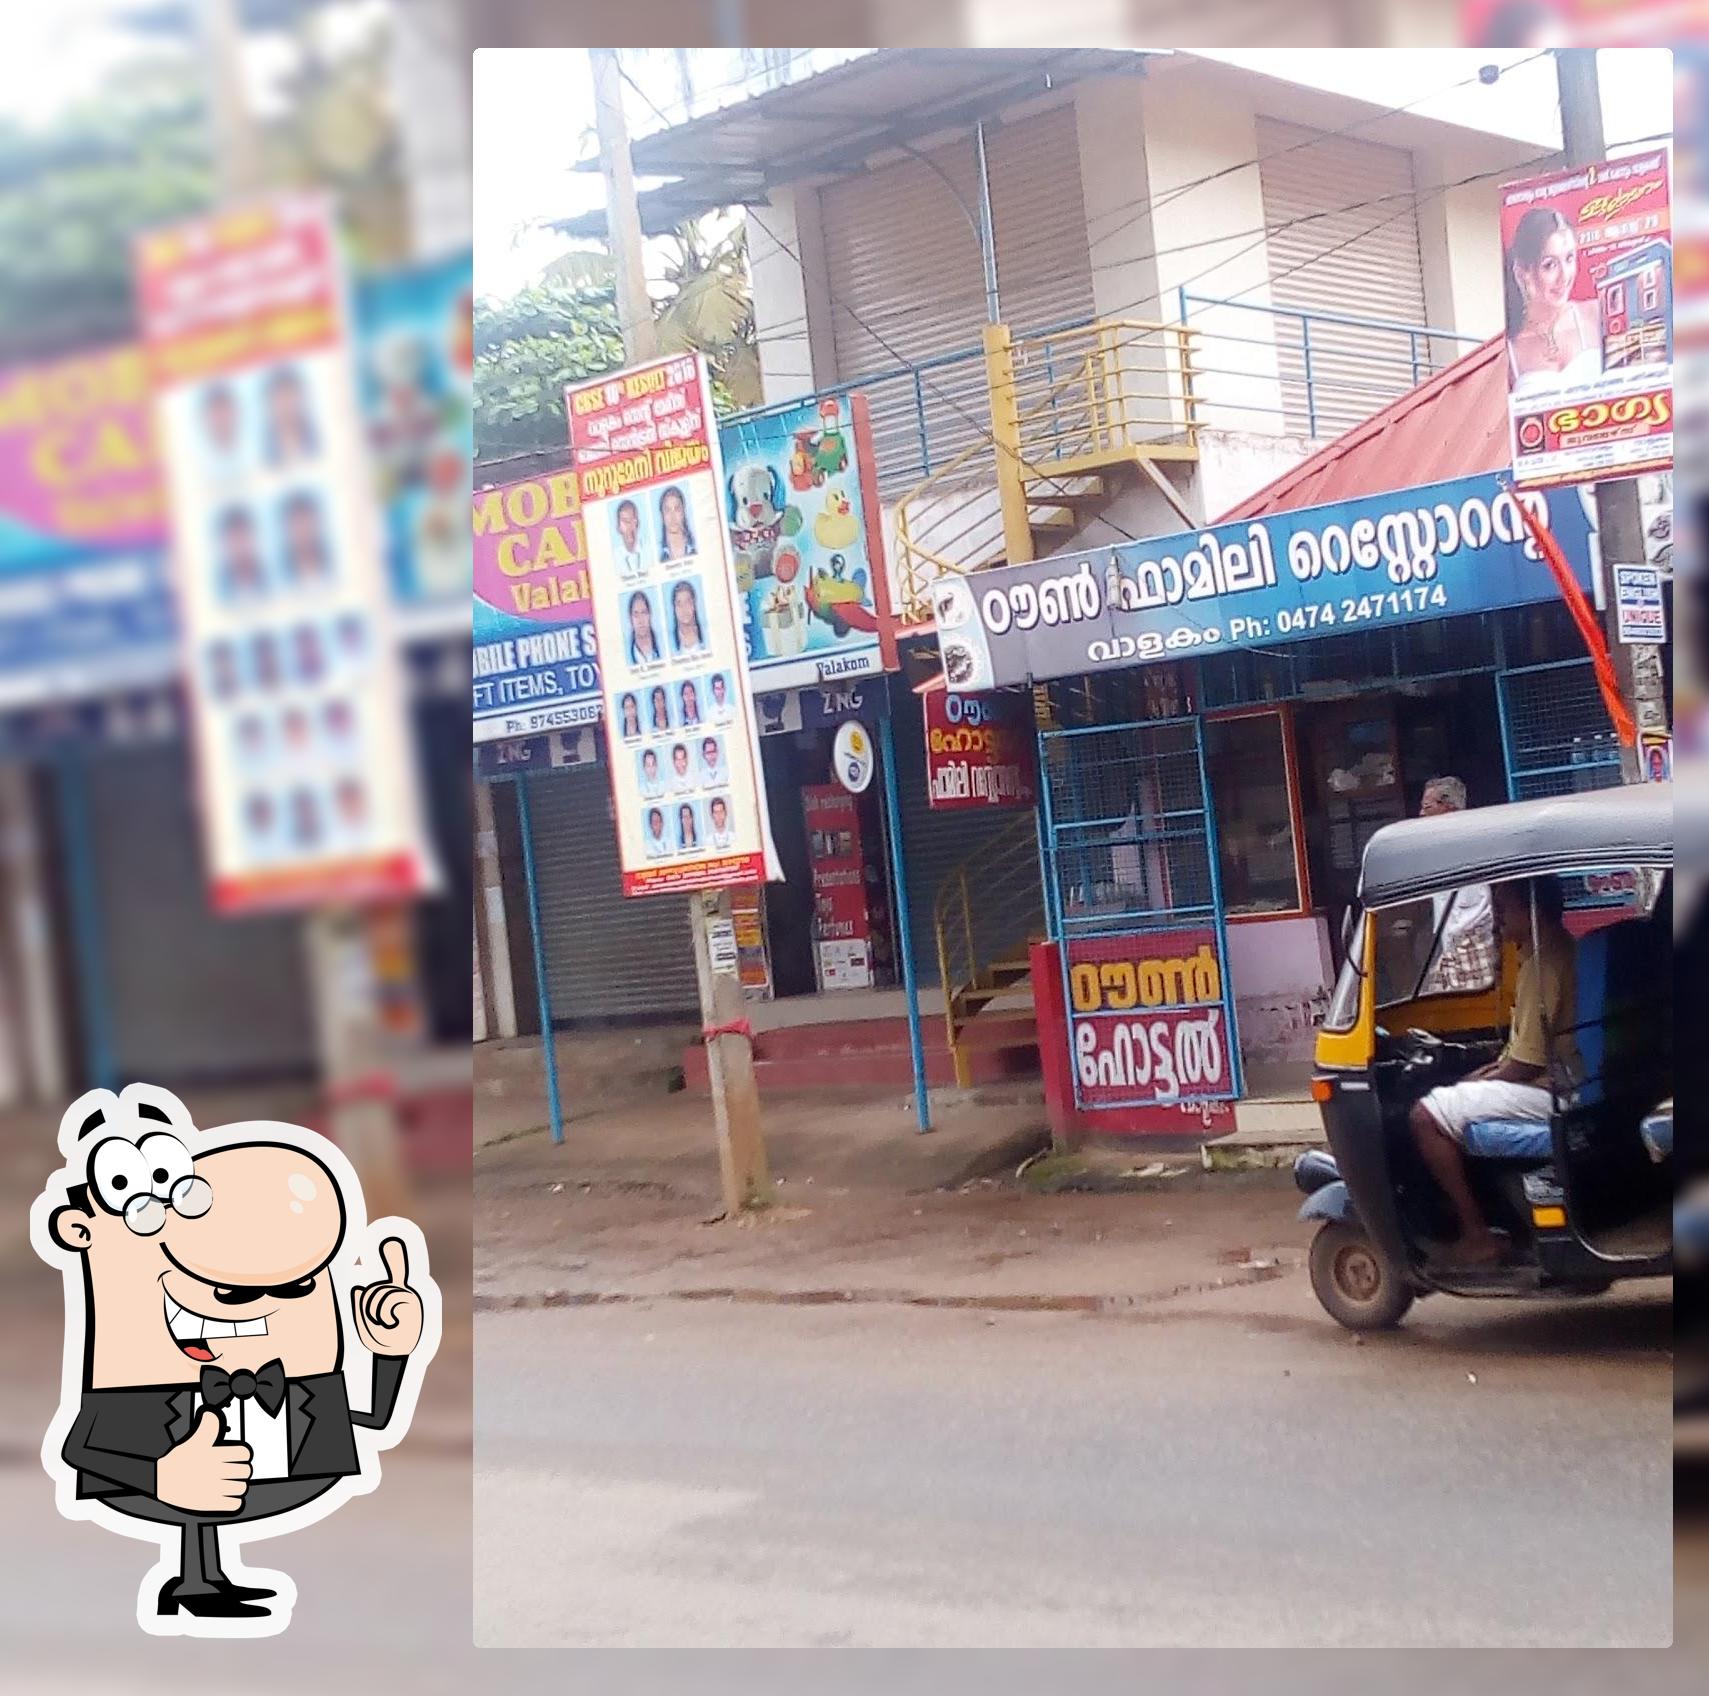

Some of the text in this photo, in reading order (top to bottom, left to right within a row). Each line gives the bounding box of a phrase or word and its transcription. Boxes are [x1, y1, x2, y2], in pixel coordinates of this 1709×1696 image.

[1548, 392, 1670, 434] ഭാഗ്യ
[1087, 583, 1448, 663] വാളകം Ph: 0474 2471174
[515, 627, 582, 669] PHONE
[816, 656, 870, 677] Valakom
[473, 683, 494, 708] FT
[1075, 1009, 1222, 1107] ഹോട്ടൽ
